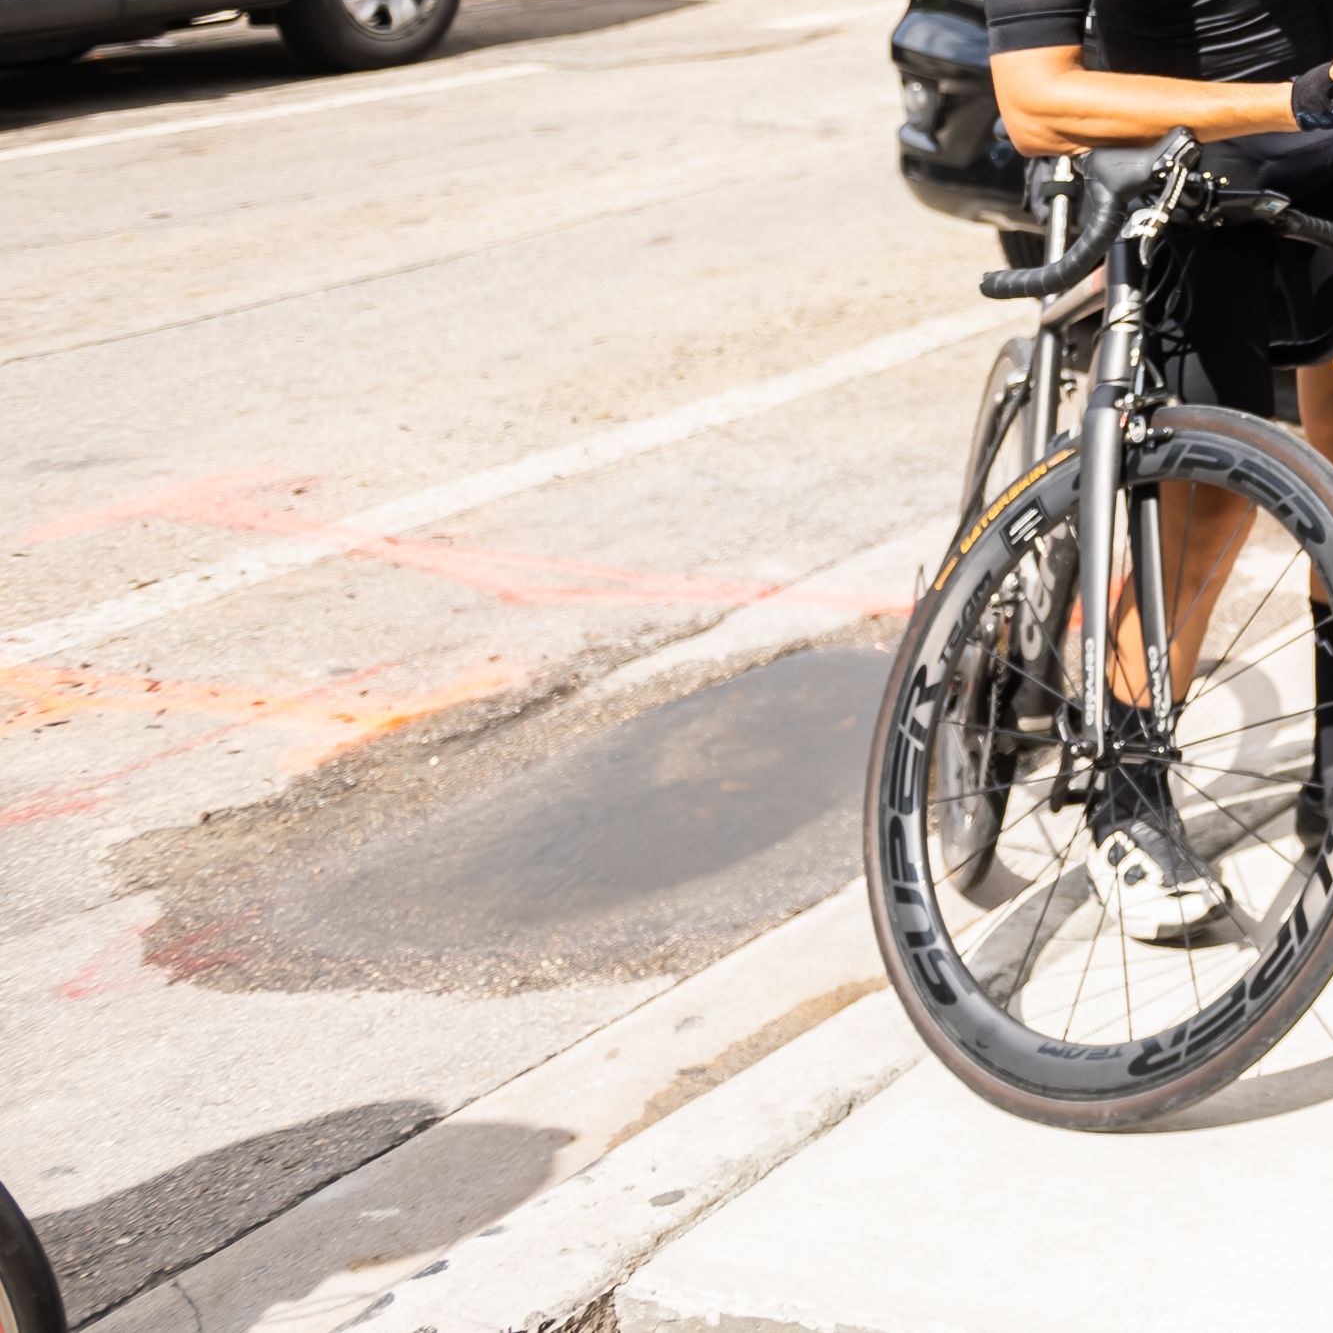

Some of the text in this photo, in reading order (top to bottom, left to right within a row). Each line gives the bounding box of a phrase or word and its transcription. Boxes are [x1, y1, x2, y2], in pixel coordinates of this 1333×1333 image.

[938, 568, 993, 667] TEAM
[888, 663, 977, 1007] SUPER
[1036, 1040, 1125, 1063] TEAM
